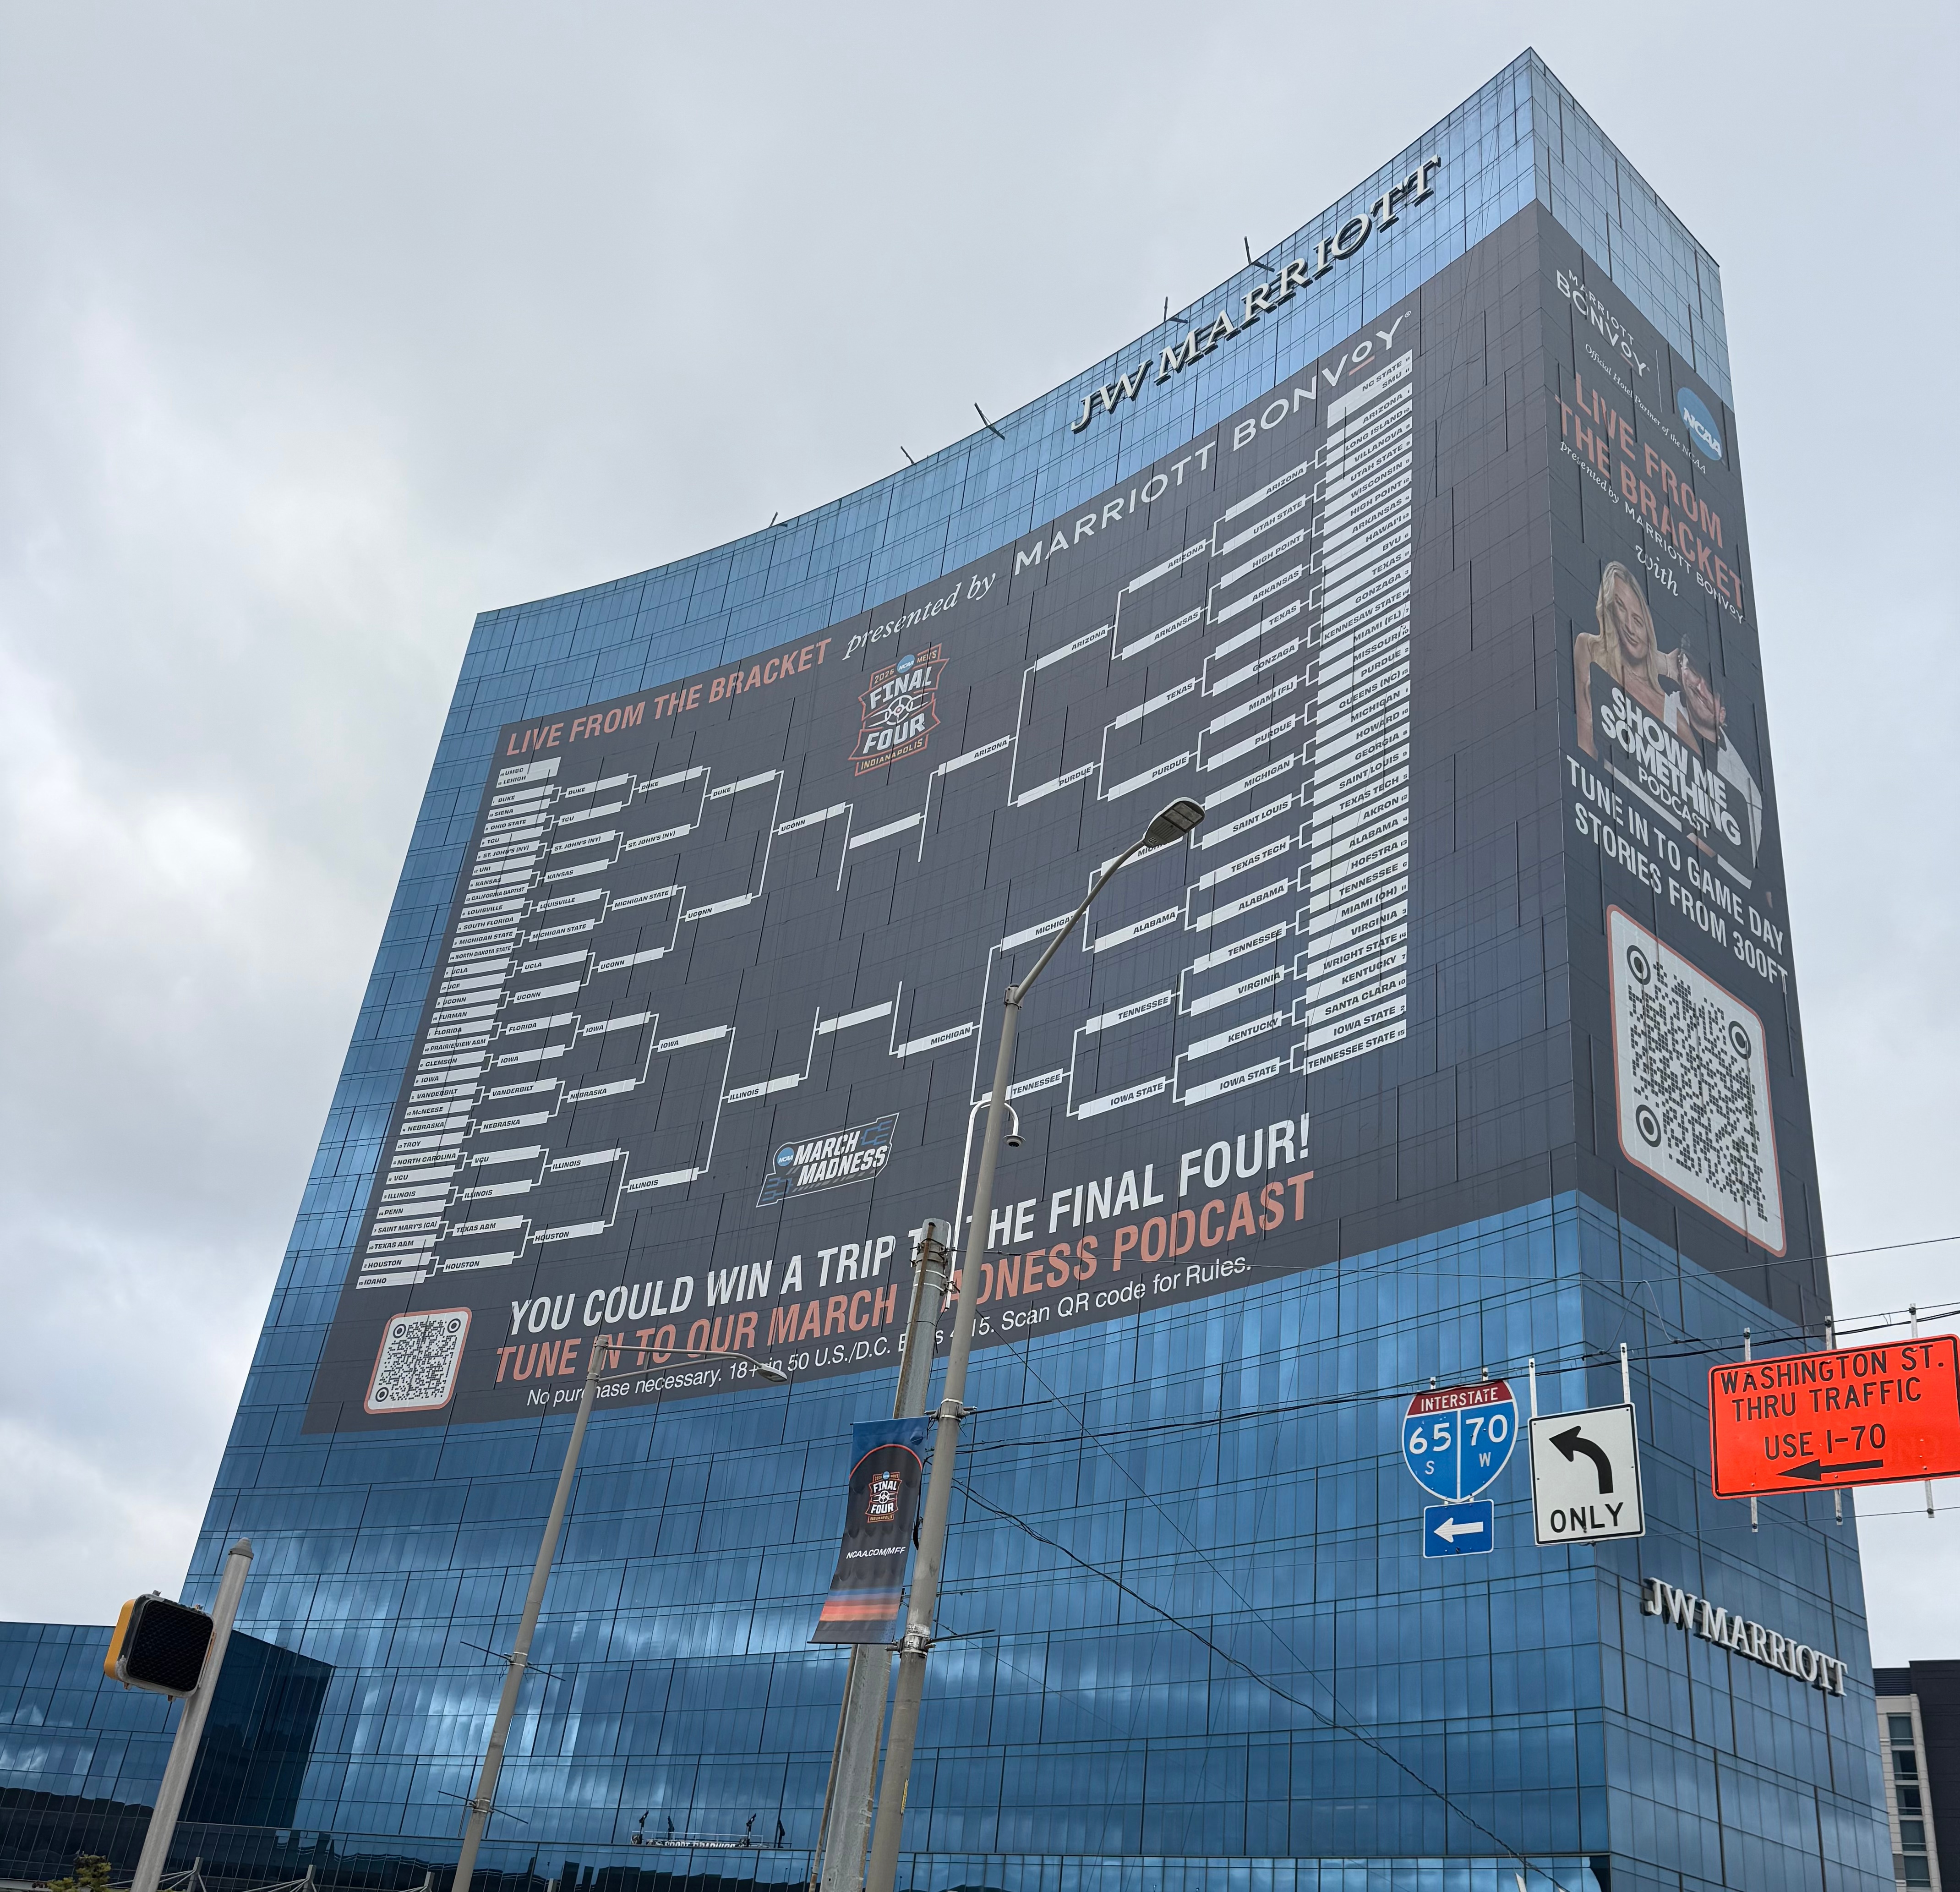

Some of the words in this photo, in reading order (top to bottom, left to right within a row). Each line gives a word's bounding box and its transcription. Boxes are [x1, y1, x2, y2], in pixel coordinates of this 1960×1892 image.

[1071, 359, 1152, 433] JW
[1155, 155, 1440, 384] MARRIOTT
[1569, 269, 1634, 344] MARRIOTT
[1556, 269, 1650, 377] BONVOY
[1363, 380, 1375, 391] NC
[1376, 361, 1402, 382] STATE
[1382, 372, 1401, 388] SMU
[1585, 344, 1611, 375] Official
[1613, 373, 1632, 398] Hotel
[1634, 395, 1660, 426] Partner
[1662, 426, 1669, 436] of
[1671, 434, 1680, 447] the
[1682, 444, 1706, 474] NCAA
[1683, 408, 1722, 457] NCAA
[1575, 372, 1635, 461] LIVE
[1644, 443, 1722, 549] FROM
[1267, 469, 1303, 494] ARIZONA
[1555, 395, 1610, 479] THE
[1621, 461, 1742, 609] BRACKET
[507, 724, 563, 756] LIVE
[570, 702, 644, 742] FROM
[654, 686, 700, 720] THE
[709, 638, 831, 702] BRACKET
[843, 590, 961, 660] presented
[967, 572, 996, 600] by
[1015, 441, 1215, 575] MARRIOTT
[1234, 316, 1403, 451] BONVOY
[1560, 441, 1606, 492] presented
[1608, 485, 1619, 503] by
[1625, 503, 1690, 574] MARRIOTT
[1696, 571, 1743, 624] BONVOY
[1253, 552, 1273, 568] HIGH
[1276, 535, 1301, 554] POINT
[1635, 545, 1678, 596] with
[1356, 574, 1401, 603] GONZAGA
[1154, 612, 1198, 640] ARKANSAS
[1269, 606, 1296, 625] TEXAS
[874, 669, 895, 684] 2026
[898, 659, 914, 671] NCAA
[917, 650, 937, 663] MEN'S
[1253, 645, 1294, 671] GONZAGA
[1361, 650, 1401, 677] PURDUE
[870, 666, 932, 710] FINAL
[863, 713, 925, 754] FOUR
[1612, 687, 1689, 775] SHOW
[1694, 751, 1727, 809] ME
[861, 739, 923, 770] INDIANAPOLIS
[974, 740, 1007, 758] ARIZONA
[1245, 760, 1289, 788] MICHIGAN
[1601, 704, 1741, 845] SOMETHING
[713, 787, 731, 796] DUKE
[1639, 766, 1711, 839] PODCAST
[1364, 797, 1398, 820] AKRON
[781, 820, 805, 831] UCONN
[1231, 855, 1260, 872] TEXAS
[1262, 842, 1286, 858] TECH
[1351, 842, 1398, 869] HOFSTRA
[1566, 755, 1623, 826] TUNE
[1629, 806, 1648, 847] IN
[1654, 827, 1681, 871] TO
[1688, 856, 1744, 925] GAME
[1749, 907, 1784, 956] DAY
[548, 870, 573, 879] KANSAS
[1339, 864, 1398, 896] TENNESSEE
[468, 905, 502, 915] LOUISVILLE
[615, 896, 648, 908] MICHIGAN
[650, 891, 669, 899] STATE
[1575, 802, 1662, 895] STORIES
[1669, 877, 1727, 948] FROM
[1733, 930, 1788, 994] 300FT
[1134, 912, 1175, 934] ALABAMA
[1342, 955, 1396, 984] KENTUCKY
[1325, 996, 1359, 1015] SANTA
[1362, 982, 1396, 1000] CLARA
[509, 1023, 536, 1032] FLORIDA
[931, 1027, 970, 1044] MICHIGAN
[1334, 1020, 1361, 1036] IOWA
[1364, 1006, 1395, 1024] STATE
[661, 1040, 678, 1049] IOWA
[1309, 1043, 1364, 1069] TENNESSEE
[1366, 1031, 1395, 1047] STATE
[493, 1086, 534, 1096] VANDERBILT
[730, 1089, 759, 1100] ILLINOIS
[1012, 1074, 1060, 1094] TENNESSEE
[484, 1120, 519, 1129] NEBRASKA
[779, 1154, 793, 1164] NCAA
[794, 1131, 860, 1166] MARCH
[553, 1160, 581, 1169] ILLINOIS
[797, 1145, 888, 1187] MADNESS
[457, 1225, 478, 1234] TEXAS
[512, 1294, 575, 1335] YOU
[584, 1276, 694, 1326] COULD
[707, 1260, 772, 1307] WIN
[781, 1255, 802, 1294] A
[818, 1235, 896, 1288] TRIP
[908, 1221, 952, 1267] T
[966, 1198, 1036, 1249] HE
[1049, 1164, 1163, 1233] FINAL
[1180, 1112, 1309, 1197] FOUR!
[446, 1261, 480, 1269] HOUSTON
[497, 1338, 581, 1382] TUNE
[588, 1333, 624, 1372] IN
[636, 1324, 676, 1365] TO
[688, 1311, 758, 1358] OUR
[768, 1284, 897, 1345] MARCH
[941, 1235, 1097, 1312] ADNESS
[1114, 1170, 1314, 1271] PODCAST
[527, 1389, 549, 1405] No
[635, 1367, 721, 1394] necessary.
[730, 1361, 759, 1379] 18+
[787, 1352, 809, 1372] 50
[815, 1337, 890, 1367] U.S./D.C.
[899, 1330, 943, 1351] Es
[1001, 1308, 1050, 1331] Scan
[1058, 1291, 1088, 1318] QR
[1095, 1280, 1146, 1308] code
[1153, 1273, 1181, 1295] for
[1185, 1258, 1252, 1286] Rules.
[1720, 1350, 1888, 1395] WASHINGTON
[1901, 1343, 1944, 1371] ST.
[1421, 1386, 1499, 1412] INTERSTATE
[1732, 1393, 1796, 1422] THRU
[1813, 1377, 1922, 1412] TRAFFIC
[1409, 1422, 1451, 1455] 65
[1466, 1415, 1508, 1446] 70
[1765, 1432, 1811, 1460] USE
[1827, 1423, 1885, 1453] I-70
[1425, 1460, 1435, 1475] S
[1479, 1452, 1491, 1467] W
[874, 1481, 897, 1493] FINAL
[871, 1503, 894, 1514] FOUR
[1551, 1502, 1623, 1534] ONLY
[846, 1547, 906, 1559] NCAA.COM/MFF
[1645, 1577, 1697, 1630] JW
[1699, 1598, 1848, 1696] MARRIOTT
